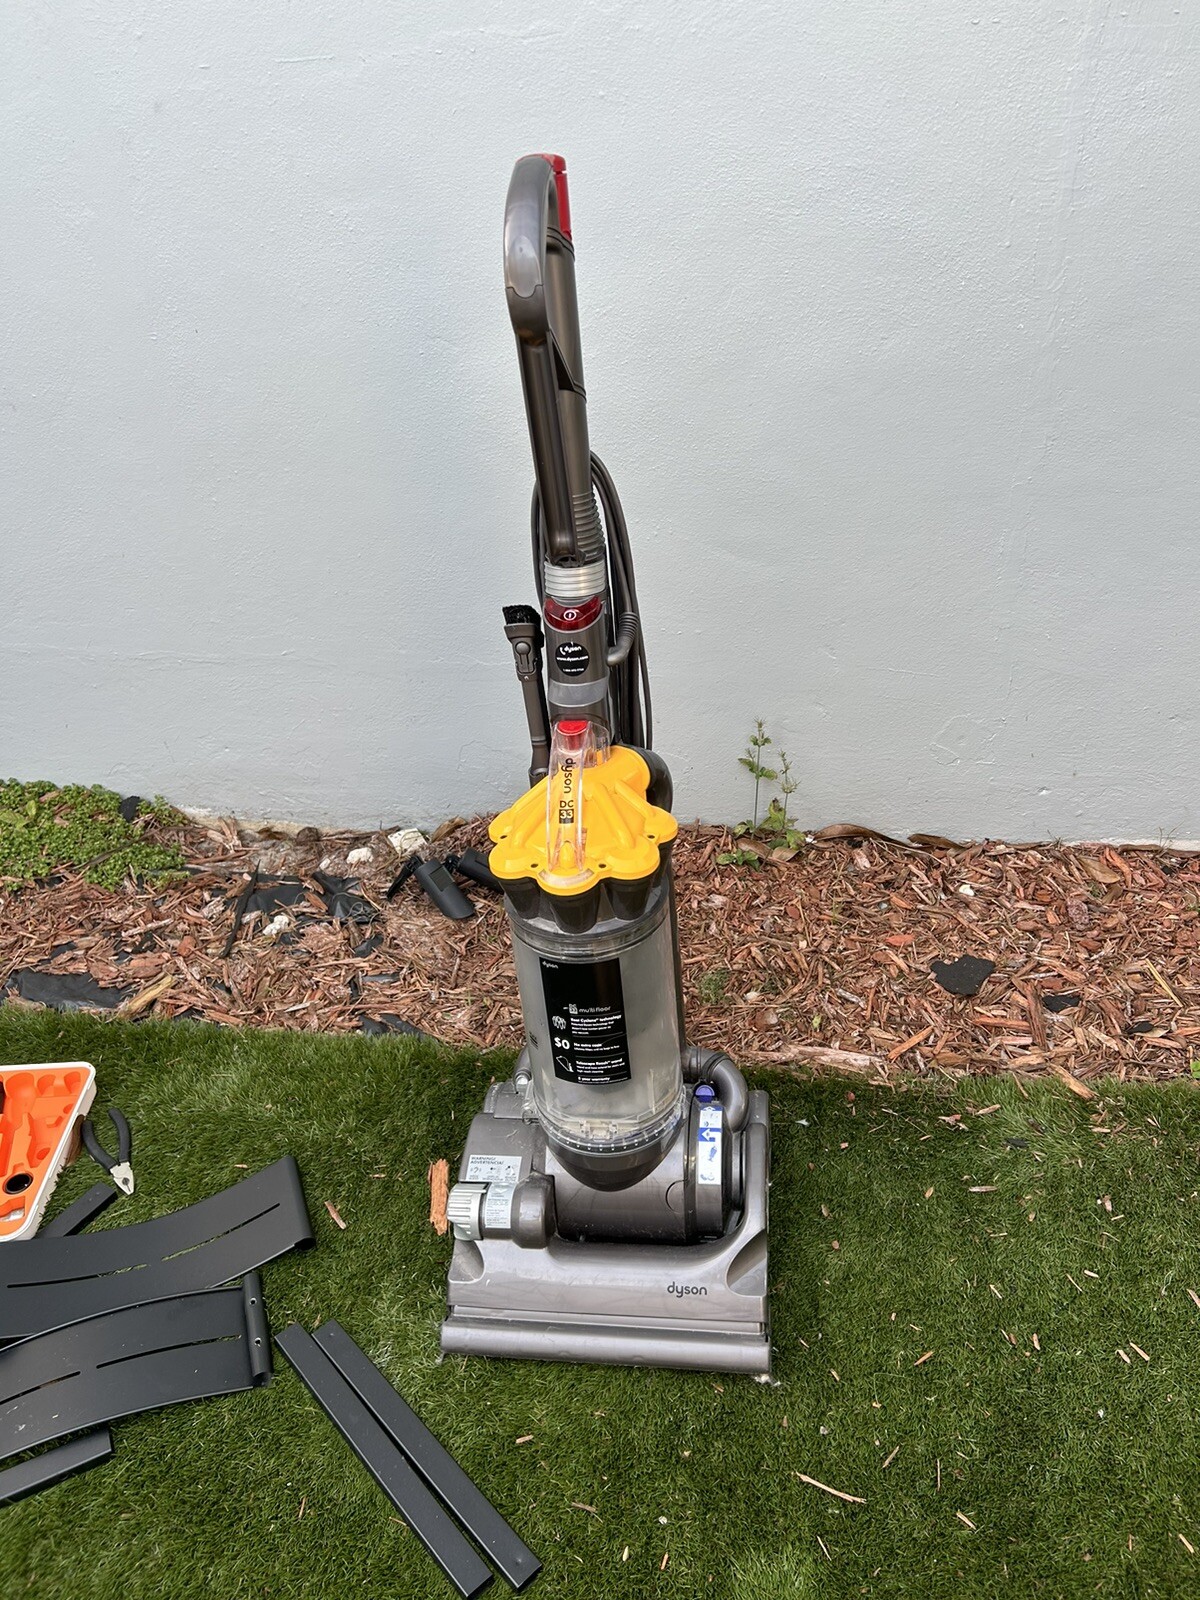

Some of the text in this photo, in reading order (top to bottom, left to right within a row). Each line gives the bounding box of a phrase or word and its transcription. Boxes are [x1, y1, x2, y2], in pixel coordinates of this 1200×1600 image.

[561, 757, 576, 794] dyson
[559, 800, 574, 808] DC
[560, 810, 573, 819] 33
[554, 1037, 570, 1050] $0
[667, 1281, 708, 1298] dyson
